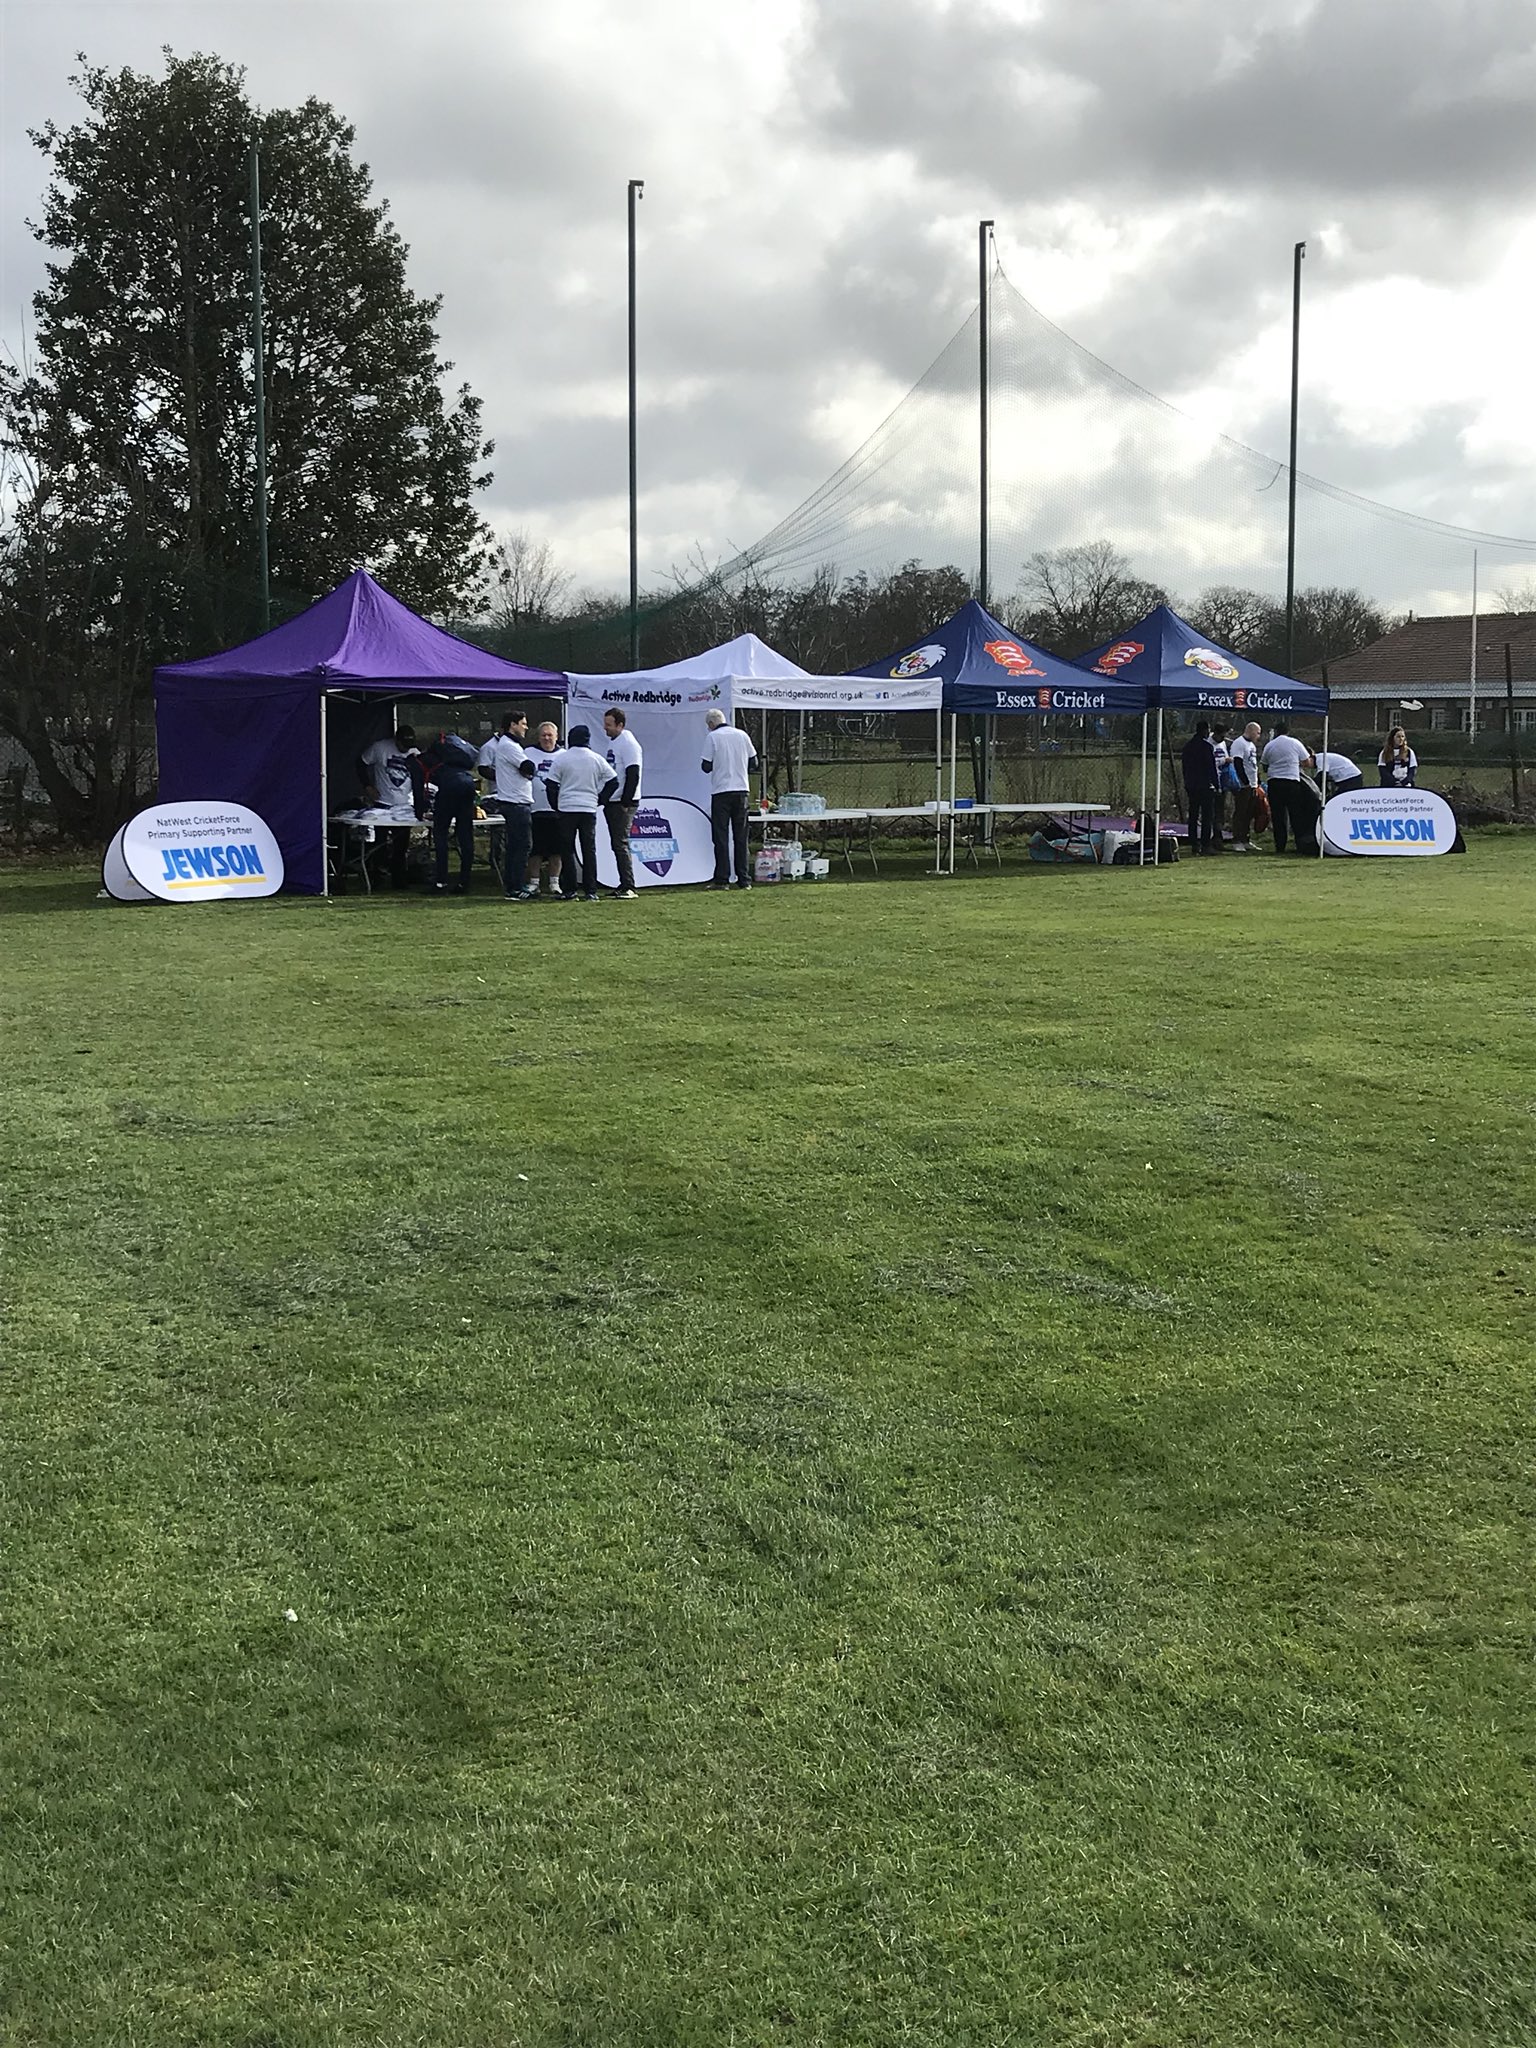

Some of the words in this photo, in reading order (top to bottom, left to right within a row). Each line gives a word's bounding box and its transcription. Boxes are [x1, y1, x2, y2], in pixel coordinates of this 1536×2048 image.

[601, 689, 630, 702] Active
[632, 690, 682, 706] Redbridge
[996, 690, 1037, 708] Essex
[1052, 690, 1105, 708] Cricket
[1198, 692, 1233, 707] Essex
[1246, 691, 1293, 709] Cricket
[1371, 805, 1408, 813] Supporting
[157, 818, 192, 826] NatWest
[194, 815, 240, 825] CricketForce
[148, 831, 180, 839] Primary
[182, 828, 225, 837] Supporting
[640, 825, 668, 834] NatWest
[1349, 819, 1435, 841] JEWSON
[161, 845, 264, 881] JEWSON
